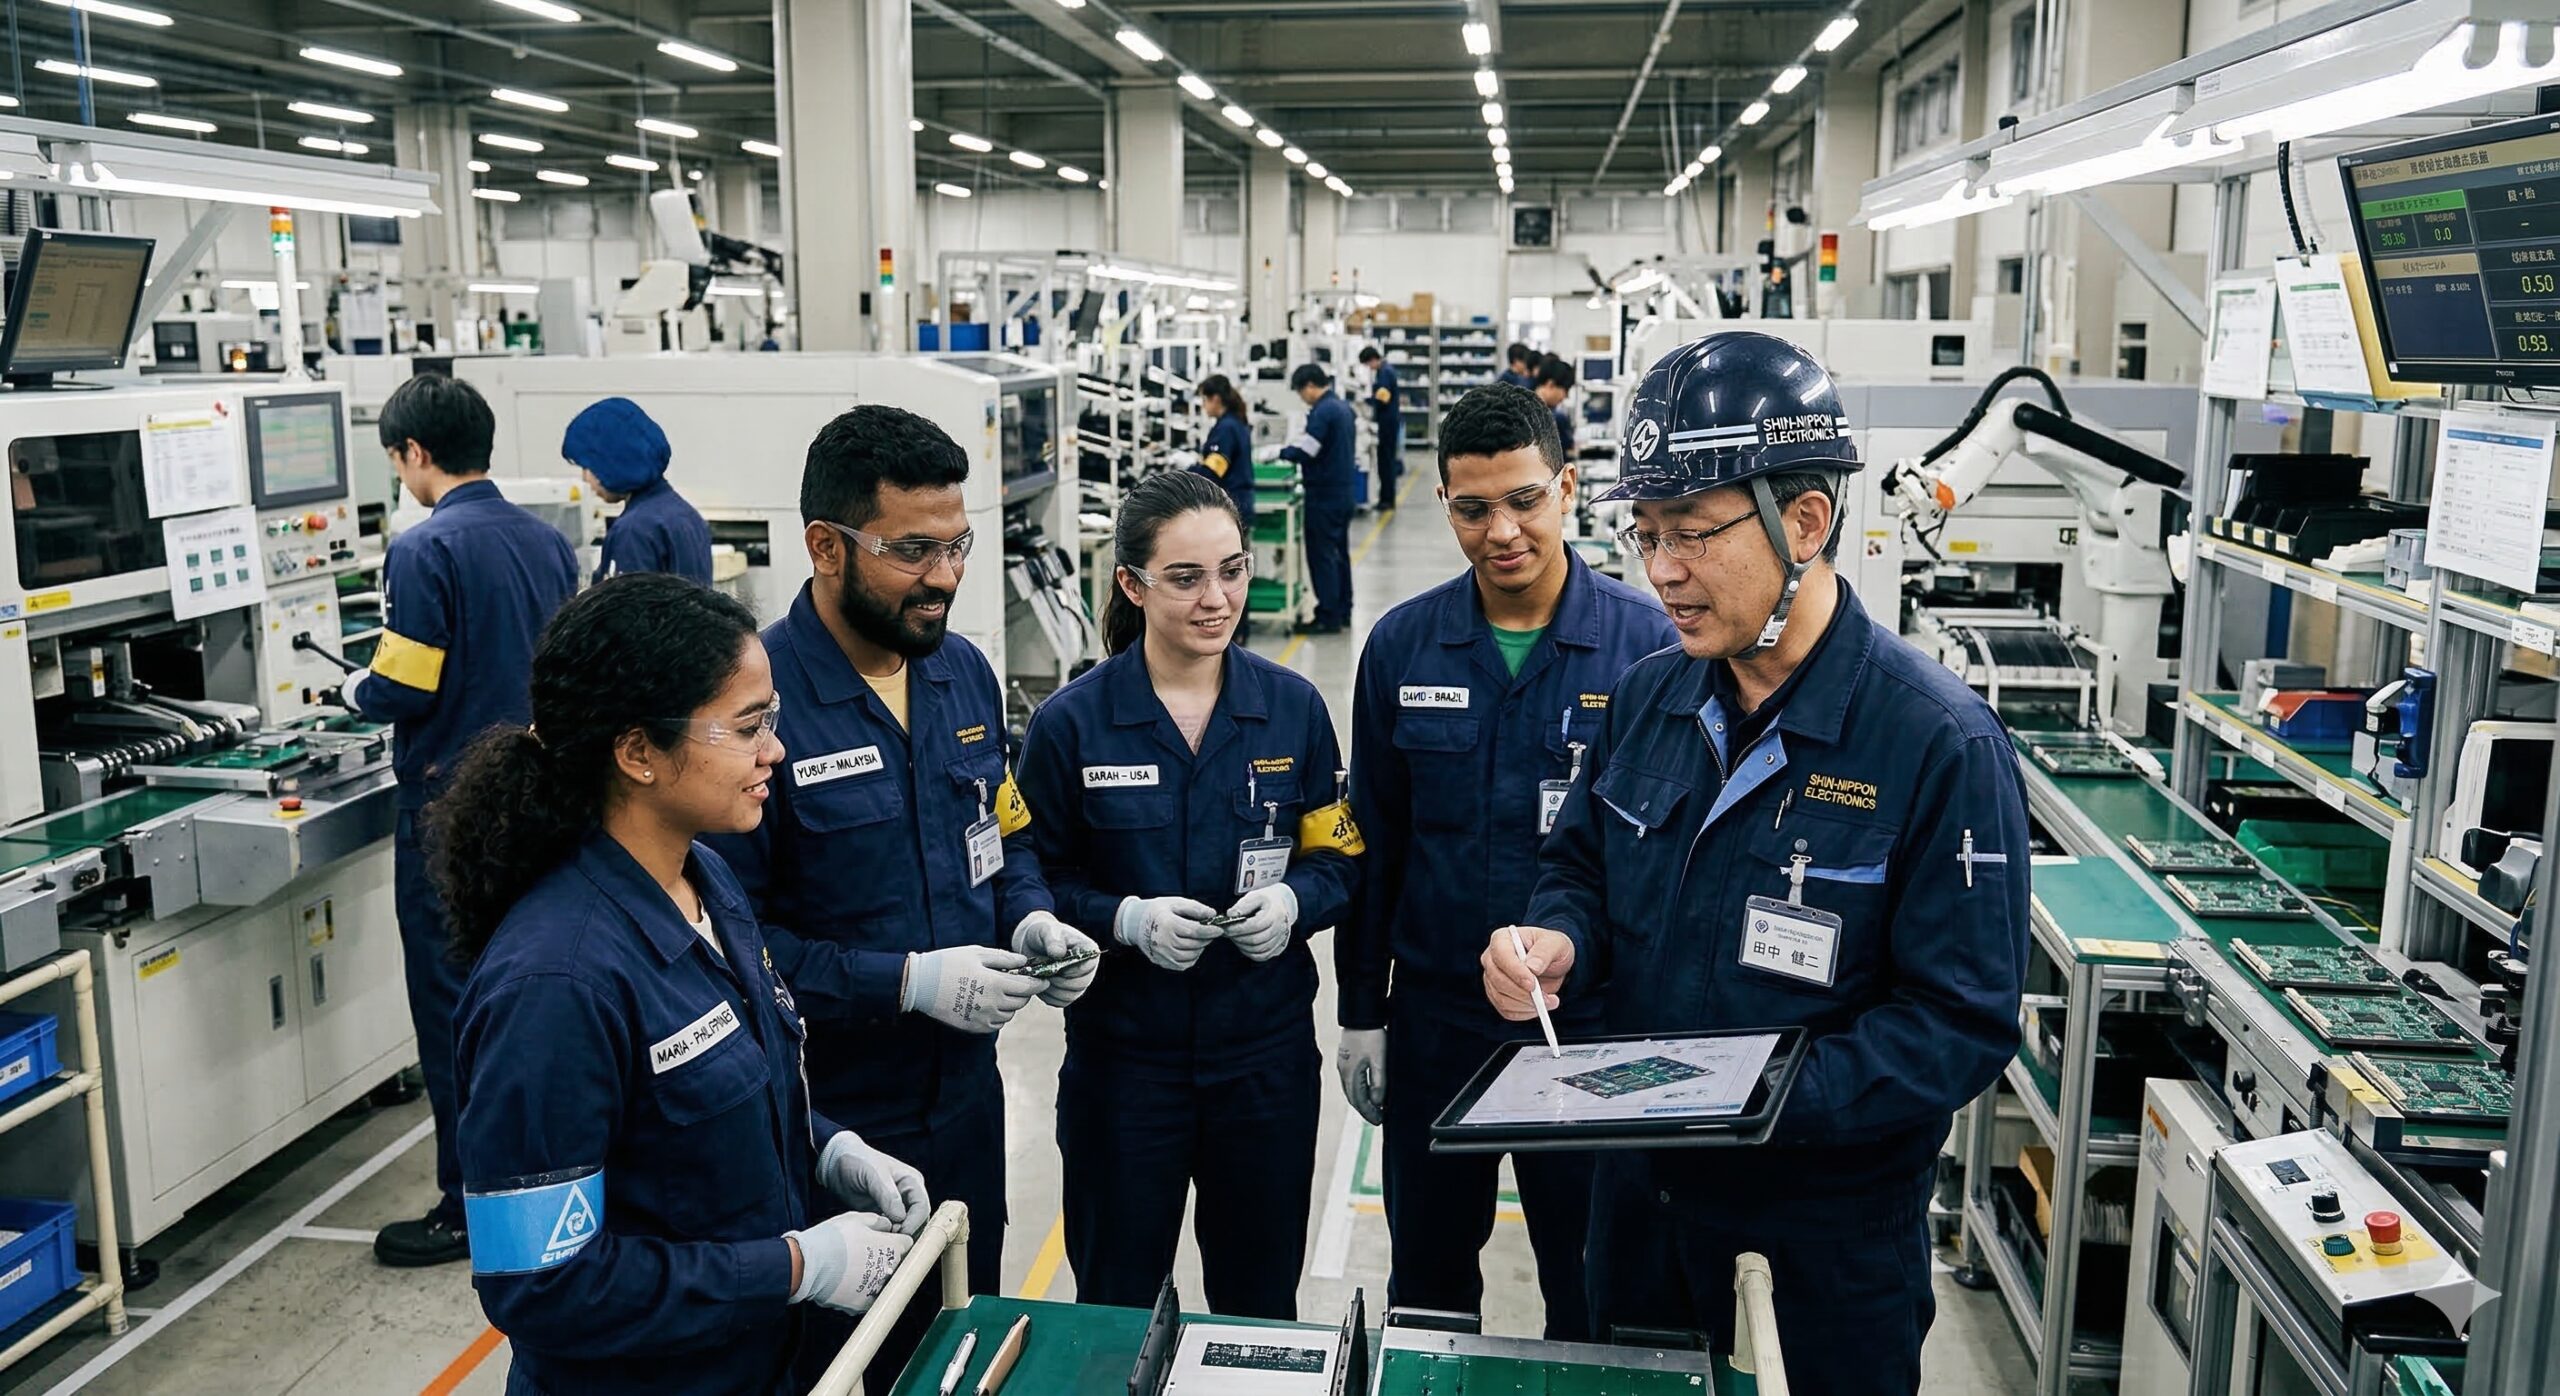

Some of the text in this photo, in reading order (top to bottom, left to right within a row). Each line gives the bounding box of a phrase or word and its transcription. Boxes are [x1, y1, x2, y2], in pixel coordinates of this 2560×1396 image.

[2434, 227, 2452, 241] 0.0
[2522, 274, 2554, 293] 0.50
[1765, 427, 1836, 446] ELECTRONICS
[796, 762, 828, 779] YUSUF
[836, 753, 878, 771] MALAYSIA
[1088, 770, 1120, 782] SARAH
[1129, 770, 1150, 780] USA
[1808, 773, 1878, 798] SHIN-NIPPON
[1804, 786, 1877, 810] ELECTRONICS
[1753, 941, 1781, 960] 田中
[656, 1039, 690, 1065] MARIA
